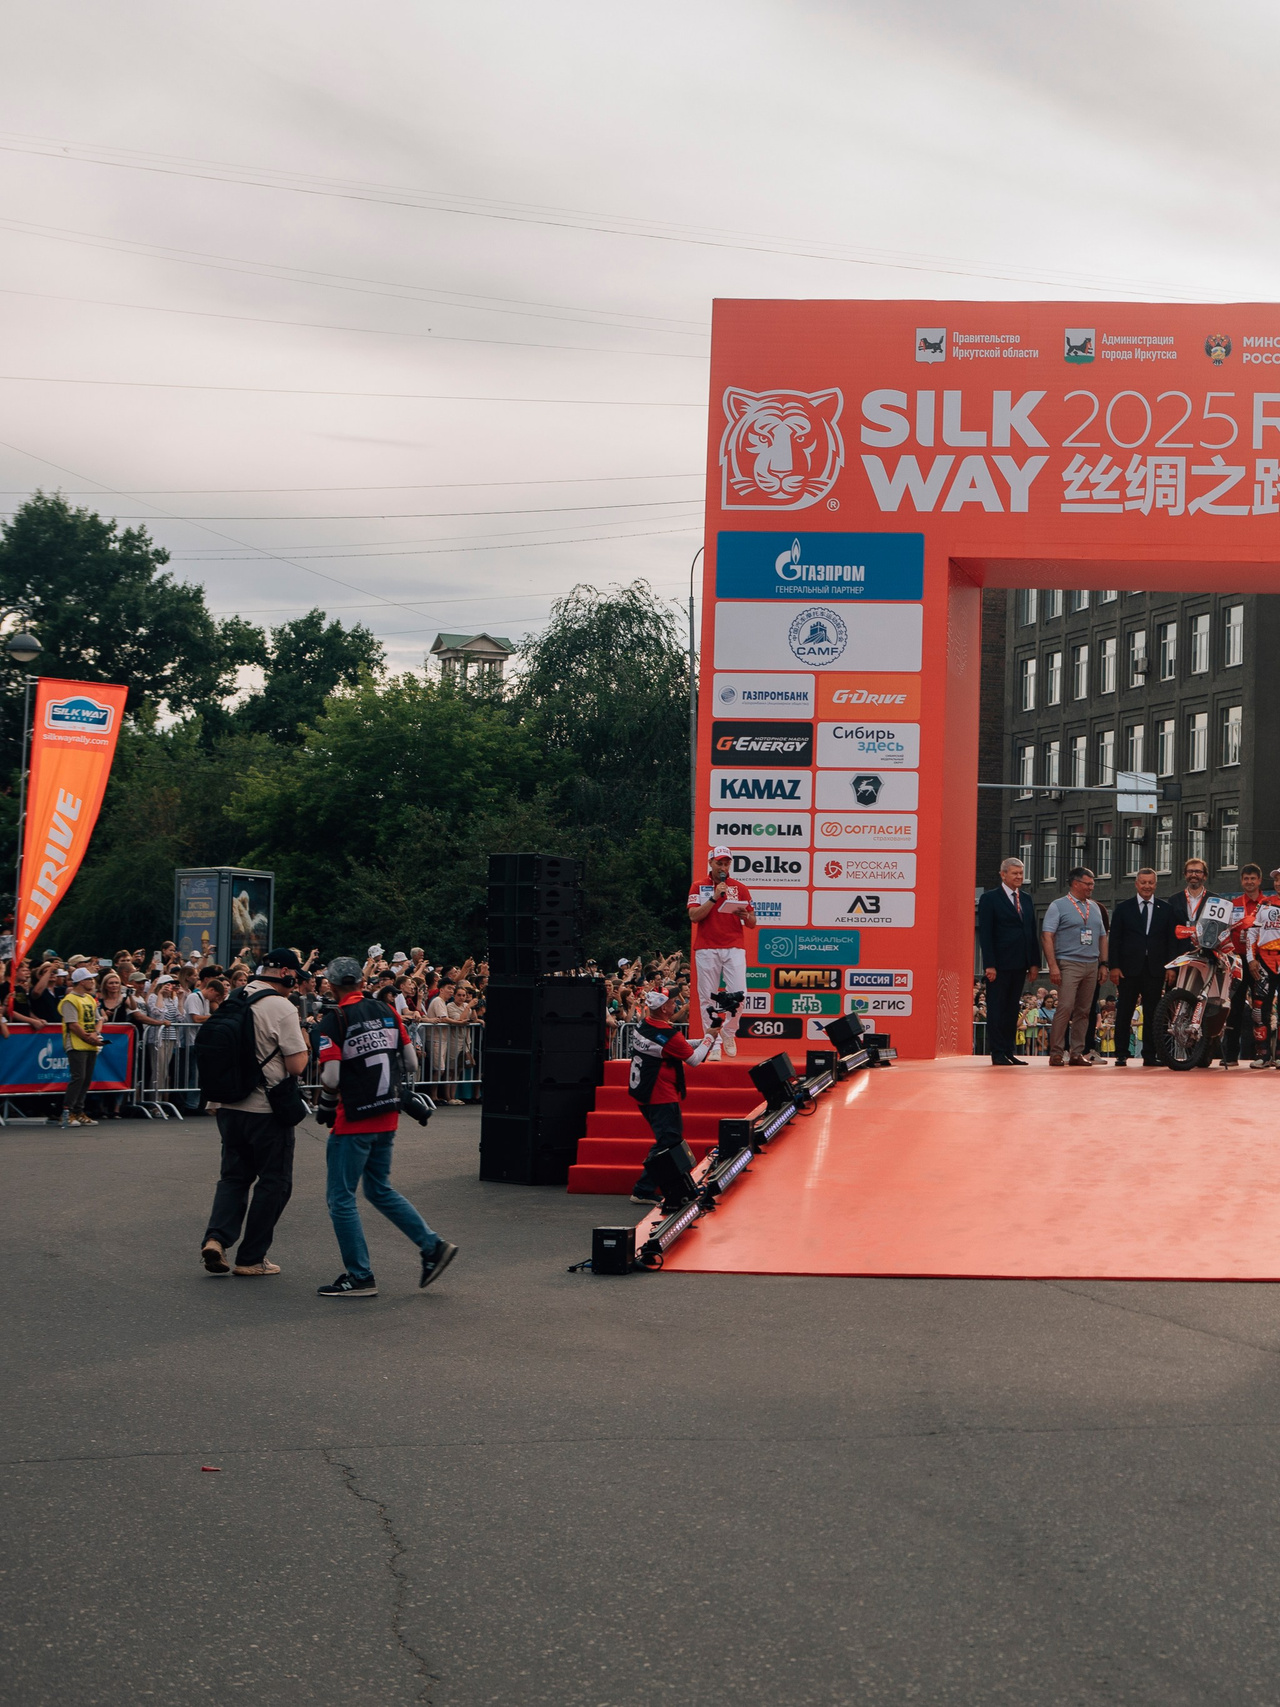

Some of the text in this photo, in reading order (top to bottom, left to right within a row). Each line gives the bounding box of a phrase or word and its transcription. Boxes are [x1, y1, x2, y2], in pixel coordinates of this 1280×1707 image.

[952, 331, 1021, 345] Правительство
[1101, 333, 1175, 347] Администрация
[952, 346, 1039, 359] Иркутской области
[1101, 348, 1178, 362] города Иркутска
[861, 389, 1050, 447] SILK
[1061, 390, 1239, 449] 2025
[860, 454, 1050, 512] WAY
[801, 565, 865, 582] ГАЗПРОМ
[775, 585, 865, 594] ГЕНЕРАЛЬНЫЙ ПАРТНЕР
[796, 646, 839, 656] CAMF
[742, 691, 809, 701] ГАЗПРОМБАНК
[53, 706, 107, 719] SILK WAY
[42, 732, 109, 746] silkwayrally.com
[833, 726, 895, 743] Сибирь
[857, 740, 904, 753] здесь
[720, 778, 801, 800] KAMAZ
[716, 823, 803, 836] MONGOLIA
[844, 825, 911, 835] СОГЛАСИЕ
[732, 855, 802, 874] Delko
[846, 861, 898, 870] РУССКАЯ
[846, 870, 905, 880] МЕХАНИКА
[1209, 905, 1226, 919] 50
[778, 970, 837, 988] МАТЧ!
[853, 975, 907, 985] РОССИЯ 24
[792, 994, 822, 1014] НТВ
[872, 1000, 905, 1010] 2ГИС
[753, 1021, 784, 1035] 360
[348, 1031, 386, 1048] OFFICIA
[356, 1039, 388, 1054] PHOTO
[364, 1053, 391, 1097] 7
[629, 1055, 643, 1090] 6
[341, 1281, 353, 1290] N
